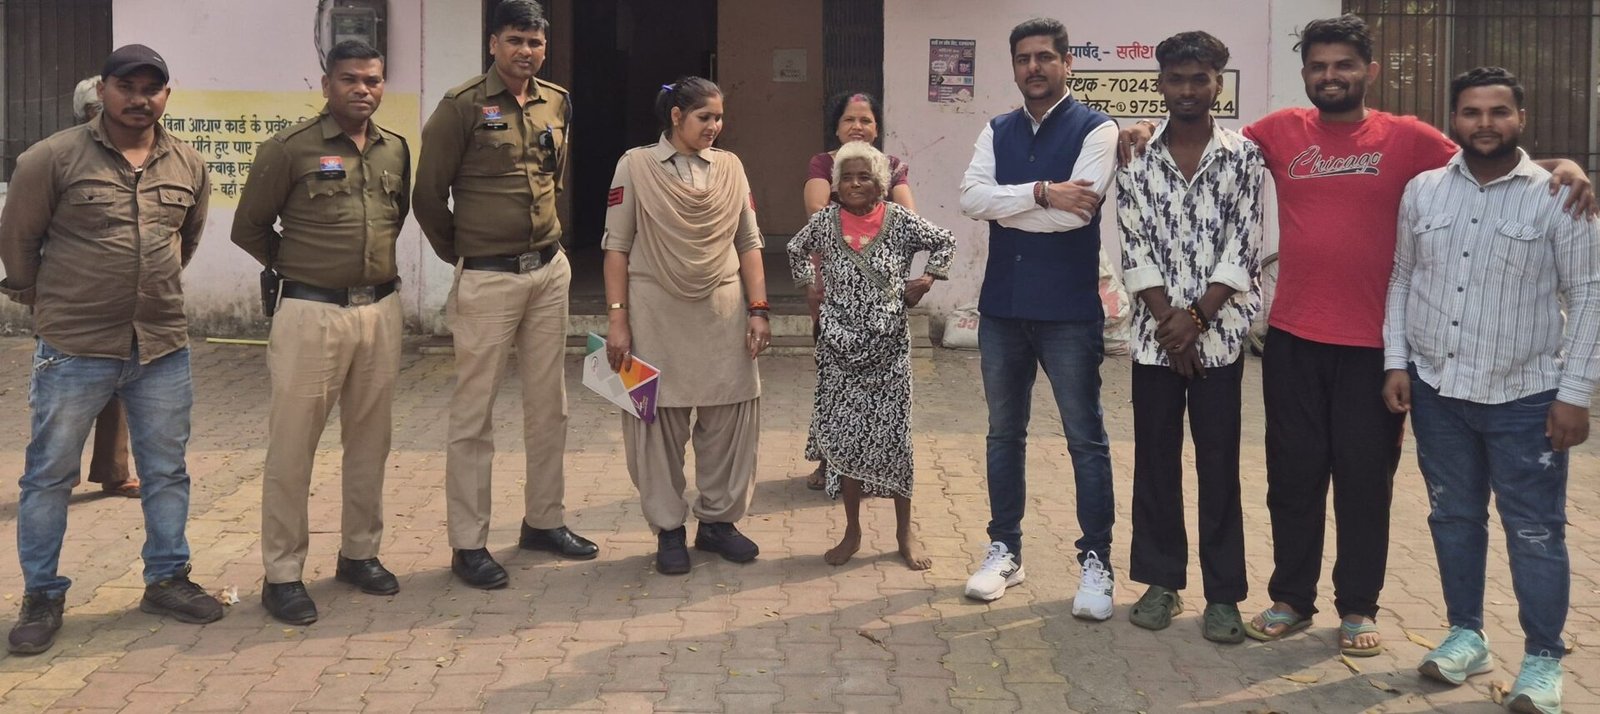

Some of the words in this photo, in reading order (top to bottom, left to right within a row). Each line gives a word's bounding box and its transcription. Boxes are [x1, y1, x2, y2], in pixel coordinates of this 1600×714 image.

[1116, 41, 1154, 60] सतीश
[162, 113, 185, 132] बिना
[188, 117, 222, 134] आधार
[224, 114, 247, 134] कार्ड
[249, 114, 261, 133] के
[214, 140, 230, 159] हुए
[232, 140, 253, 156] पाए
[206, 161, 236, 177] म्बाकू
[1288, 145, 1383, 179] Chicago
